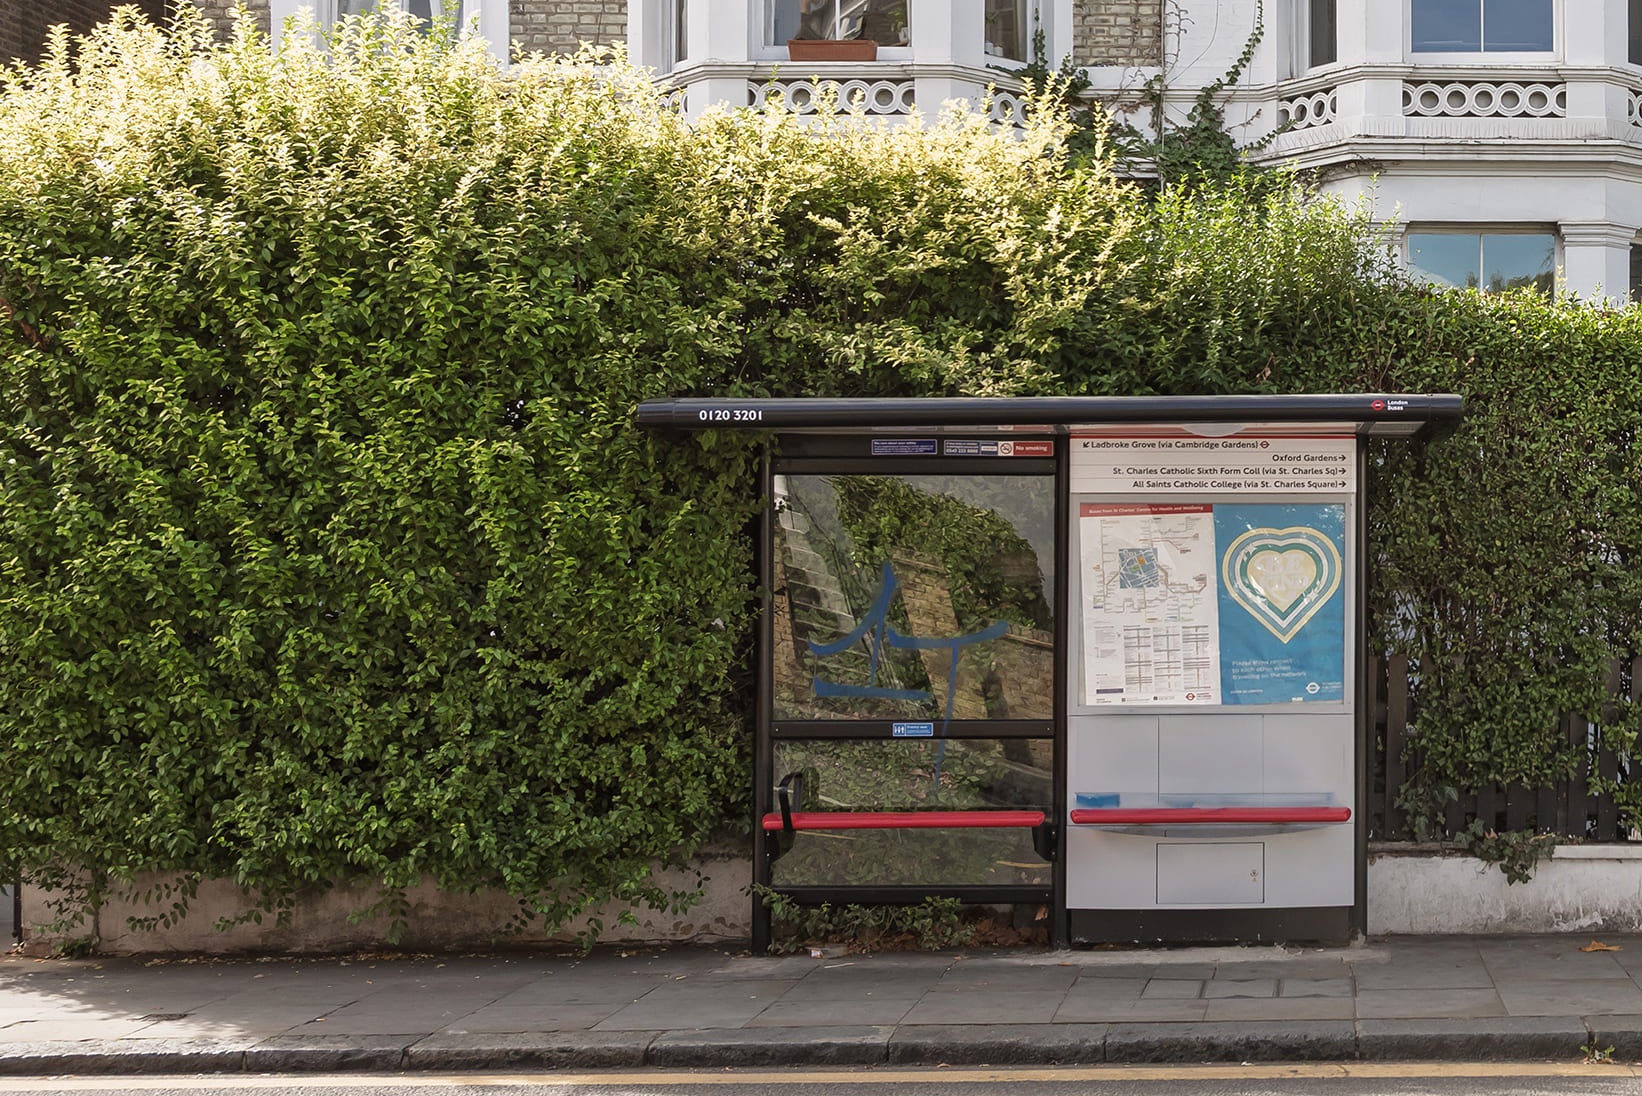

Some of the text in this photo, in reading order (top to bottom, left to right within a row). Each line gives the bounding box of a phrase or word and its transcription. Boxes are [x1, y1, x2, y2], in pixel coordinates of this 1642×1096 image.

[699, 410, 763, 421] 0120 3201
[1091, 441, 1258, 450] Ladbroke Grove (via Cambridge Gardens)
[1272, 454, 1338, 462] Oxford Gardens
[1112, 467, 1338, 476] St. Charles Catholic Sixth Form Coll (via St. Charles Sq)
[1146, 480, 1172, 488] Saints
[1174, 480, 1209, 488] Catholic
[1210, 480, 1242, 489] College
[1244, 480, 1259, 488] (via
[1260, 480, 1272, 488] St.
[1274, 480, 1306, 488] Charles
[1307, 480, 1338, 489] Square)
